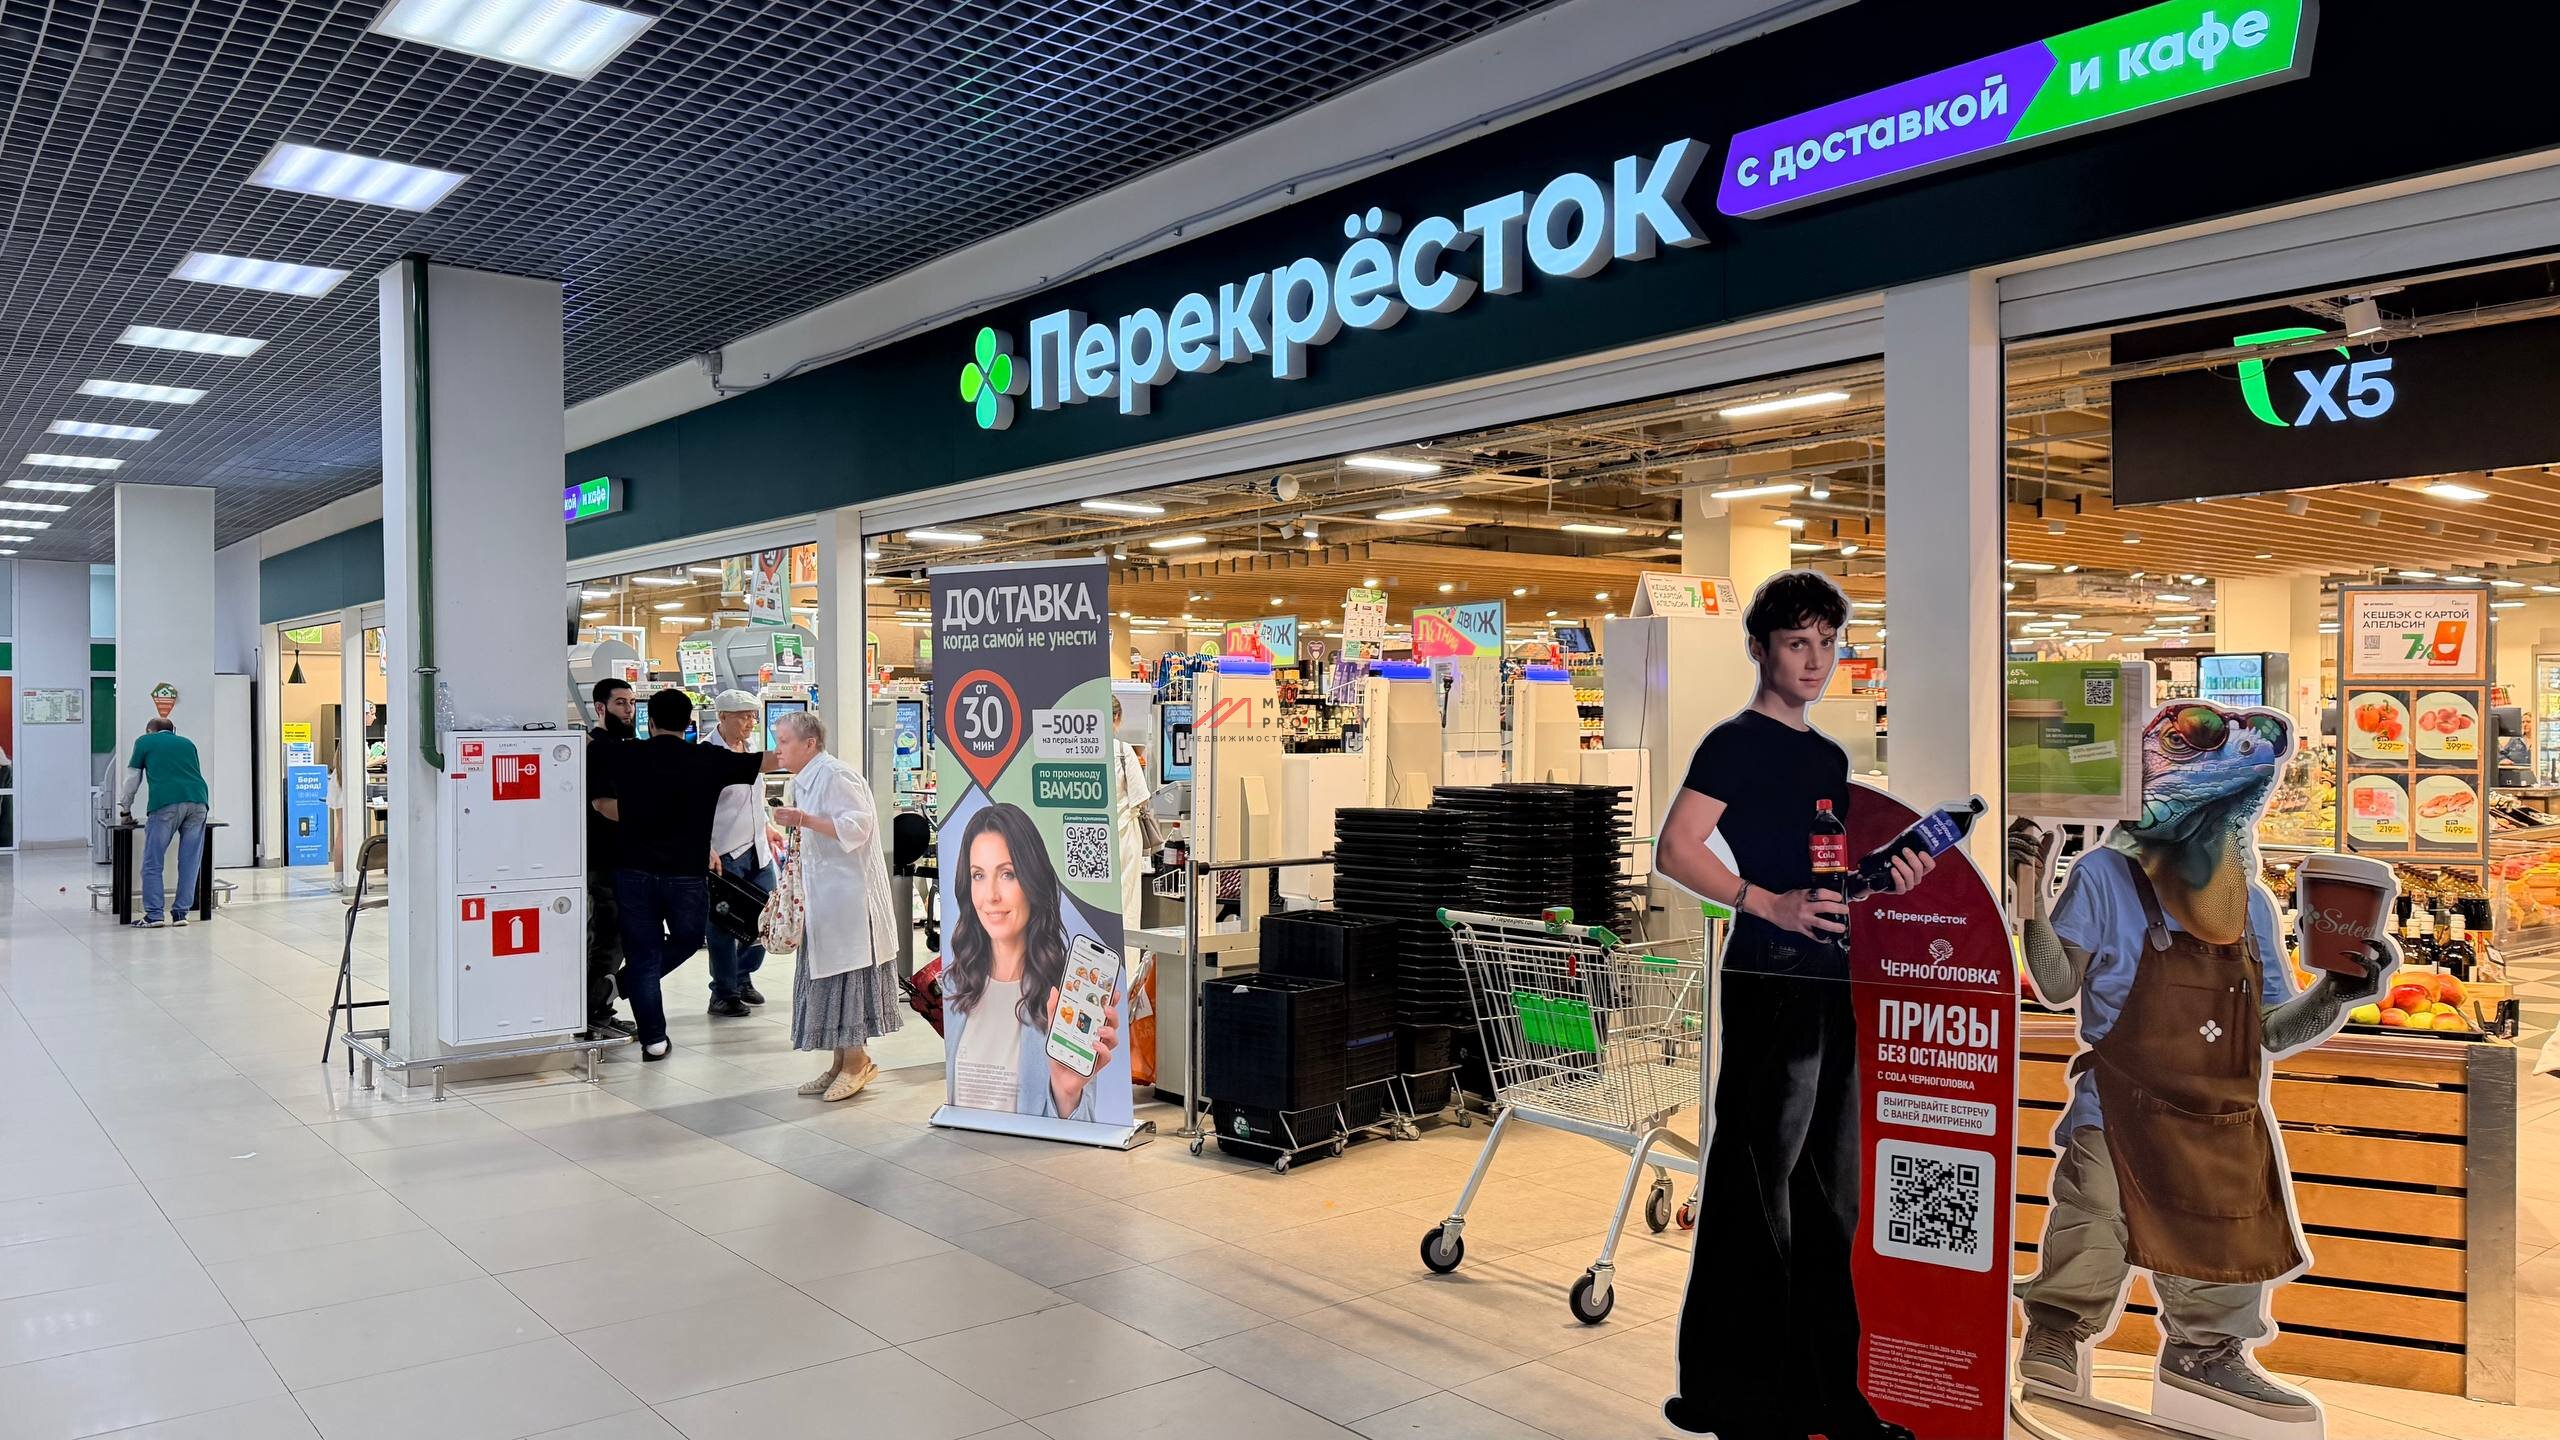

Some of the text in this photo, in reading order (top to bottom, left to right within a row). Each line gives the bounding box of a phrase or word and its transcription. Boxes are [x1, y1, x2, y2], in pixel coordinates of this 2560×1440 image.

[1768, 74, 2009, 187] доставкой
[2069, 54, 2101, 95] и
[2117, 9, 2270, 82] кафе
[1029, 138, 1702, 414] Перекрёсток
[2293, 357, 2396, 427] X5
[588, 485, 606, 507] кафе
[942, 581, 1102, 632] ДОСТАВКА,
[2363, 608, 2470, 619] КЕШБЭК С КАРТОЙ
[2362, 620, 2426, 629] АПЕЛЬСИН
[943, 633, 980, 652] когда
[983, 627, 1024, 649] самой
[1028, 632, 1045, 647] не
[1048, 629, 1097, 651] унести
[2402, 633, 2435, 660] 7%
[2019, 678, 2039, 686] день
[962, 695, 1003, 739] 30
[1052, 736, 1078, 745] первый
[2377, 742, 2393, 751] 229
[2445, 742, 2462, 751] 399
[1039, 770, 1101, 780] по промокоду
[2379, 825, 2393, 833] 219
[1817, 850, 1836, 860] Cola
[1887, 909, 1967, 925] Перекрёсток
[1878, 998, 2000, 1050] ПРИЗЫ
[1878, 1043, 1998, 1074] БЕЗ ОСТАНОВКИ
[1908, 1073, 1976, 1091] ЧЕРНОГОЛОВКА
[1883, 1096, 1990, 1118] ВЫИГРЫВАЙТЕ ВСТРЕЧУ
[1891, 1109, 1920, 1122] ВАНЕЙ
[1921, 1113, 1983, 1129] ДМИТРИЕНКО
